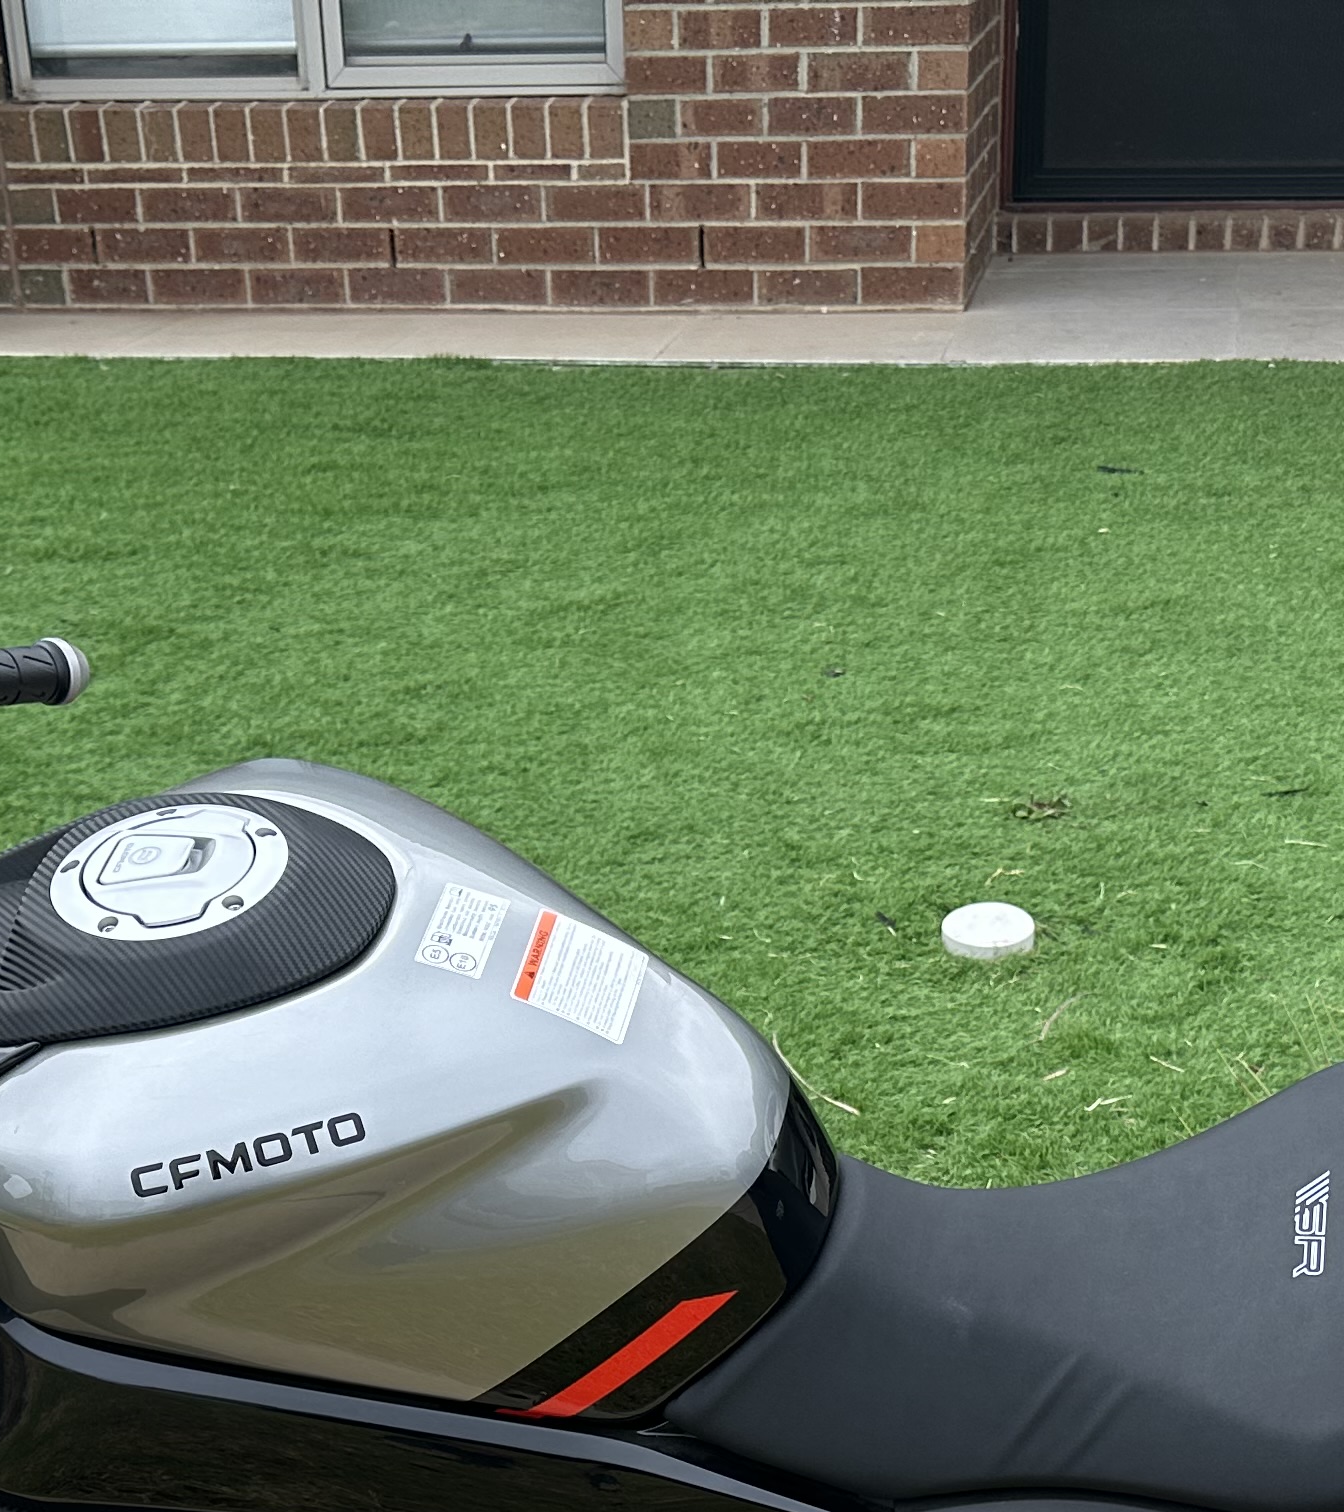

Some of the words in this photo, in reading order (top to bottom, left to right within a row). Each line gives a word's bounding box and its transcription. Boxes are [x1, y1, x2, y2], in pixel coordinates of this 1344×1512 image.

[430, 948, 442, 960] E5
[528, 930, 549, 967] WARNING
[456, 955, 469, 970] E10
[130, 1112, 366, 1198] CFMOTO
